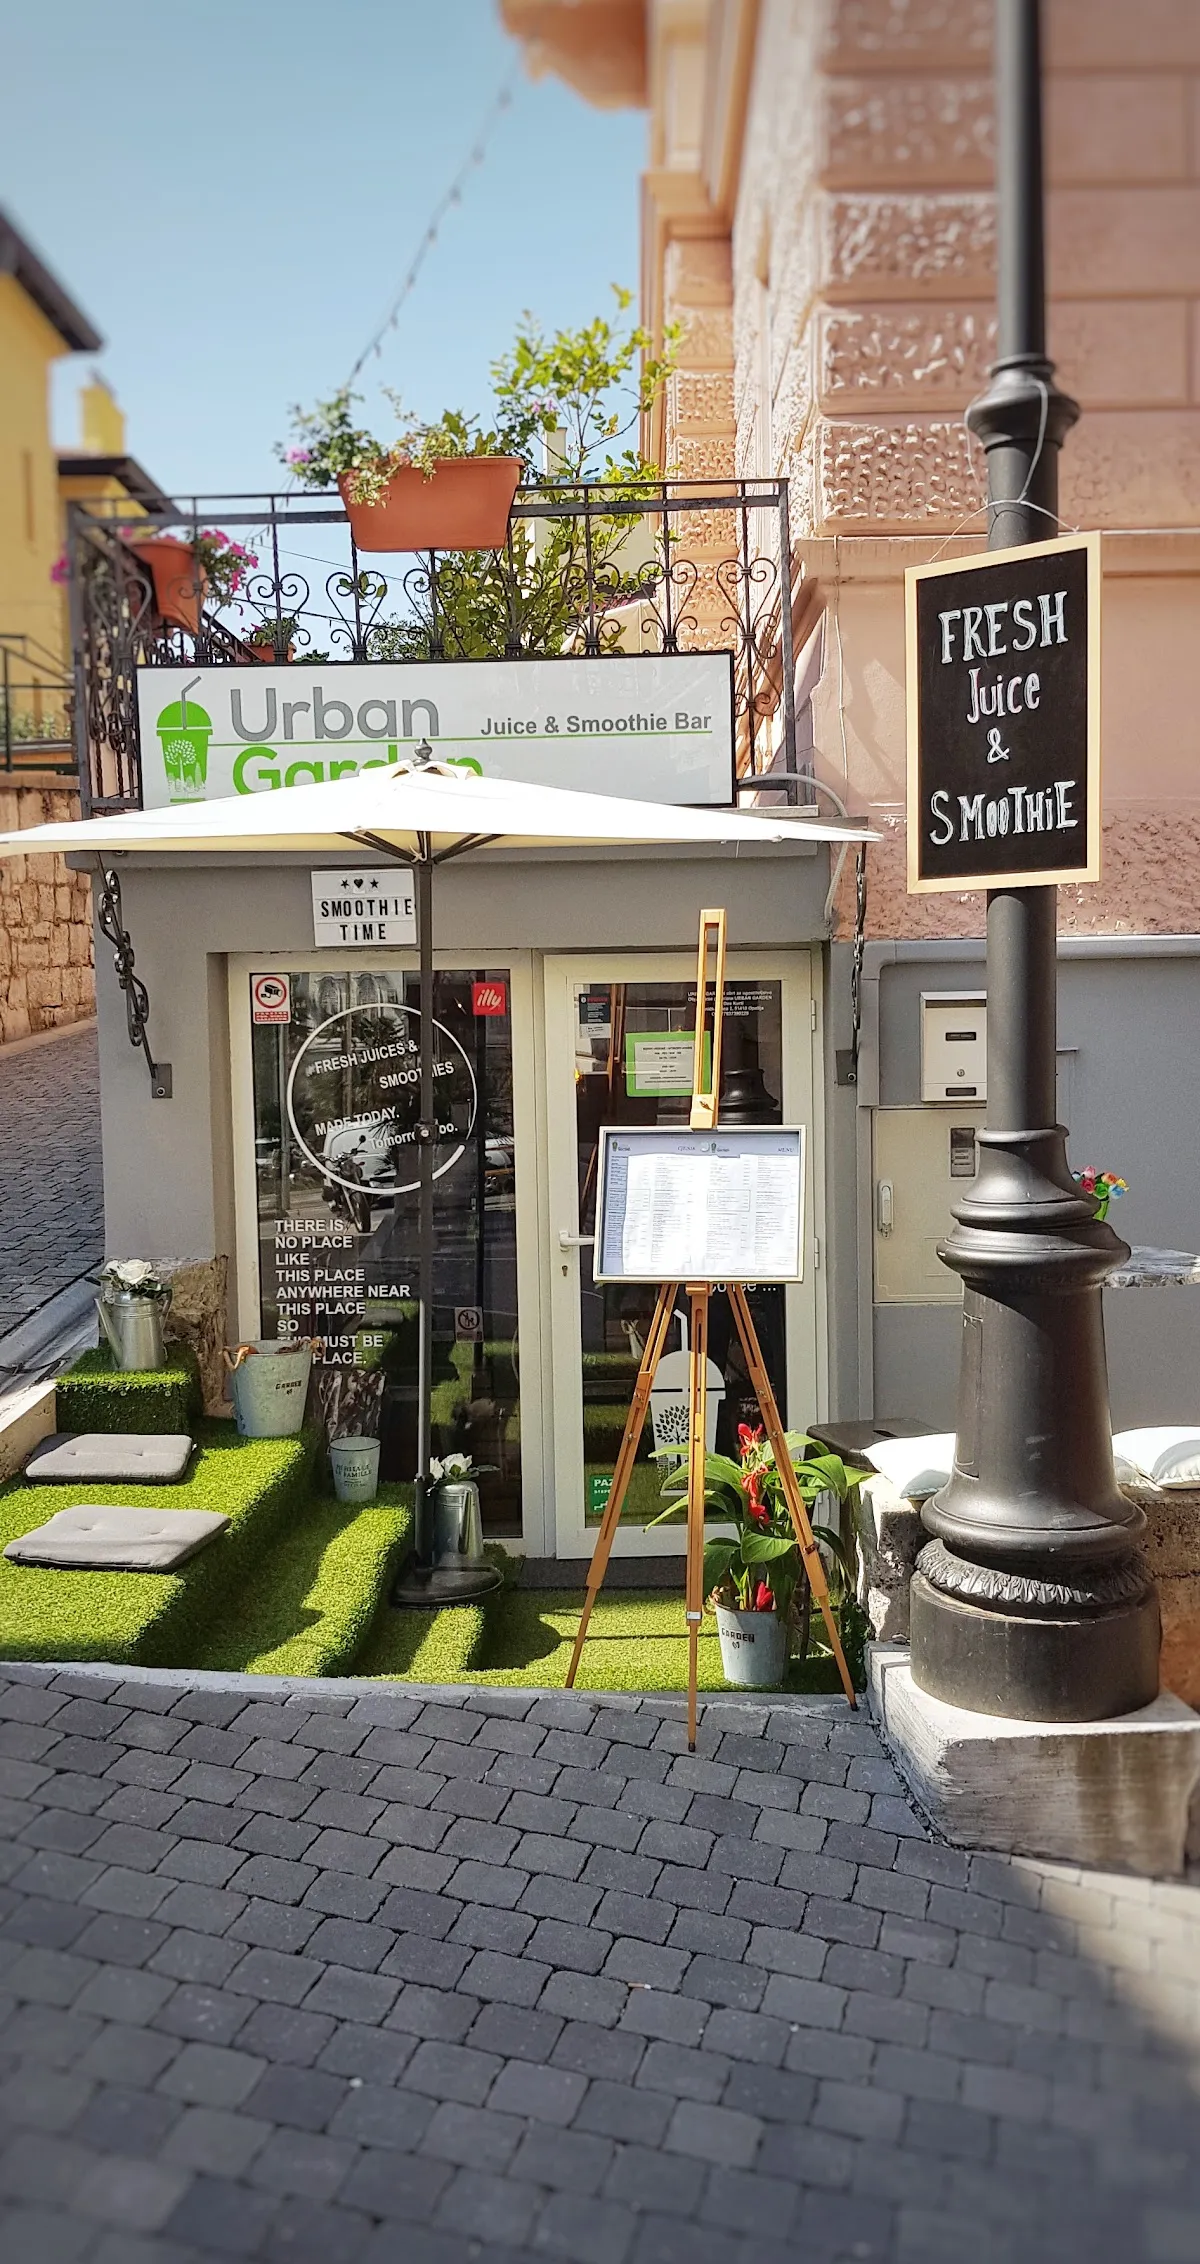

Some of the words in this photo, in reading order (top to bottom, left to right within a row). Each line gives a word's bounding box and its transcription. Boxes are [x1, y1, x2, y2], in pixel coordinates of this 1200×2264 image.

[938, 590, 1068, 664] FRESH
[967, 667, 1041, 724] Juice
[230, 686, 439, 742] Urban
[480, 718, 537, 736] Juice
[544, 716, 559, 733] &
[566, 713, 668, 733] Smoothie
[675, 712, 712, 730] Bar
[987, 727, 1010, 764] &
[232, 744, 483, 796] Gar
[321, 898, 413, 918] SMOOTHIE
[340, 923, 386, 941] TIME
[477, 988, 502, 1011] illy
[314, 1053, 358, 1074] FRESH
[361, 1042, 405, 1064] JUICES
[408, 1040, 419, 1053] &
[380, 1061, 454, 1089] SMOOTIES
[315, 1116, 352, 1136] MADE
[354, 1106, 400, 1128] TODAY.
[369, 1131, 417, 1150] Tomorr
[274, 1220, 325, 1232] THERE
[329, 1219, 344, 1232] IS
[275, 1236, 298, 1249] NO
[302, 1235, 353, 1248] PLACE
[275, 1253, 310, 1265] LIKE
[276, 1269, 310, 1282] THIS
[314, 1269, 365, 1281] PLACE
[276, 1286, 364, 1299] ANYWHERE
[368, 1285, 411, 1298] NEAR
[277, 1303, 311, 1315] THIS
[315, 1302, 366, 1315] PLACE
[277, 1320, 299, 1332] SO
[363, 1335, 384, 1347] BE
[721, 1627, 755, 1643] GARDEN
